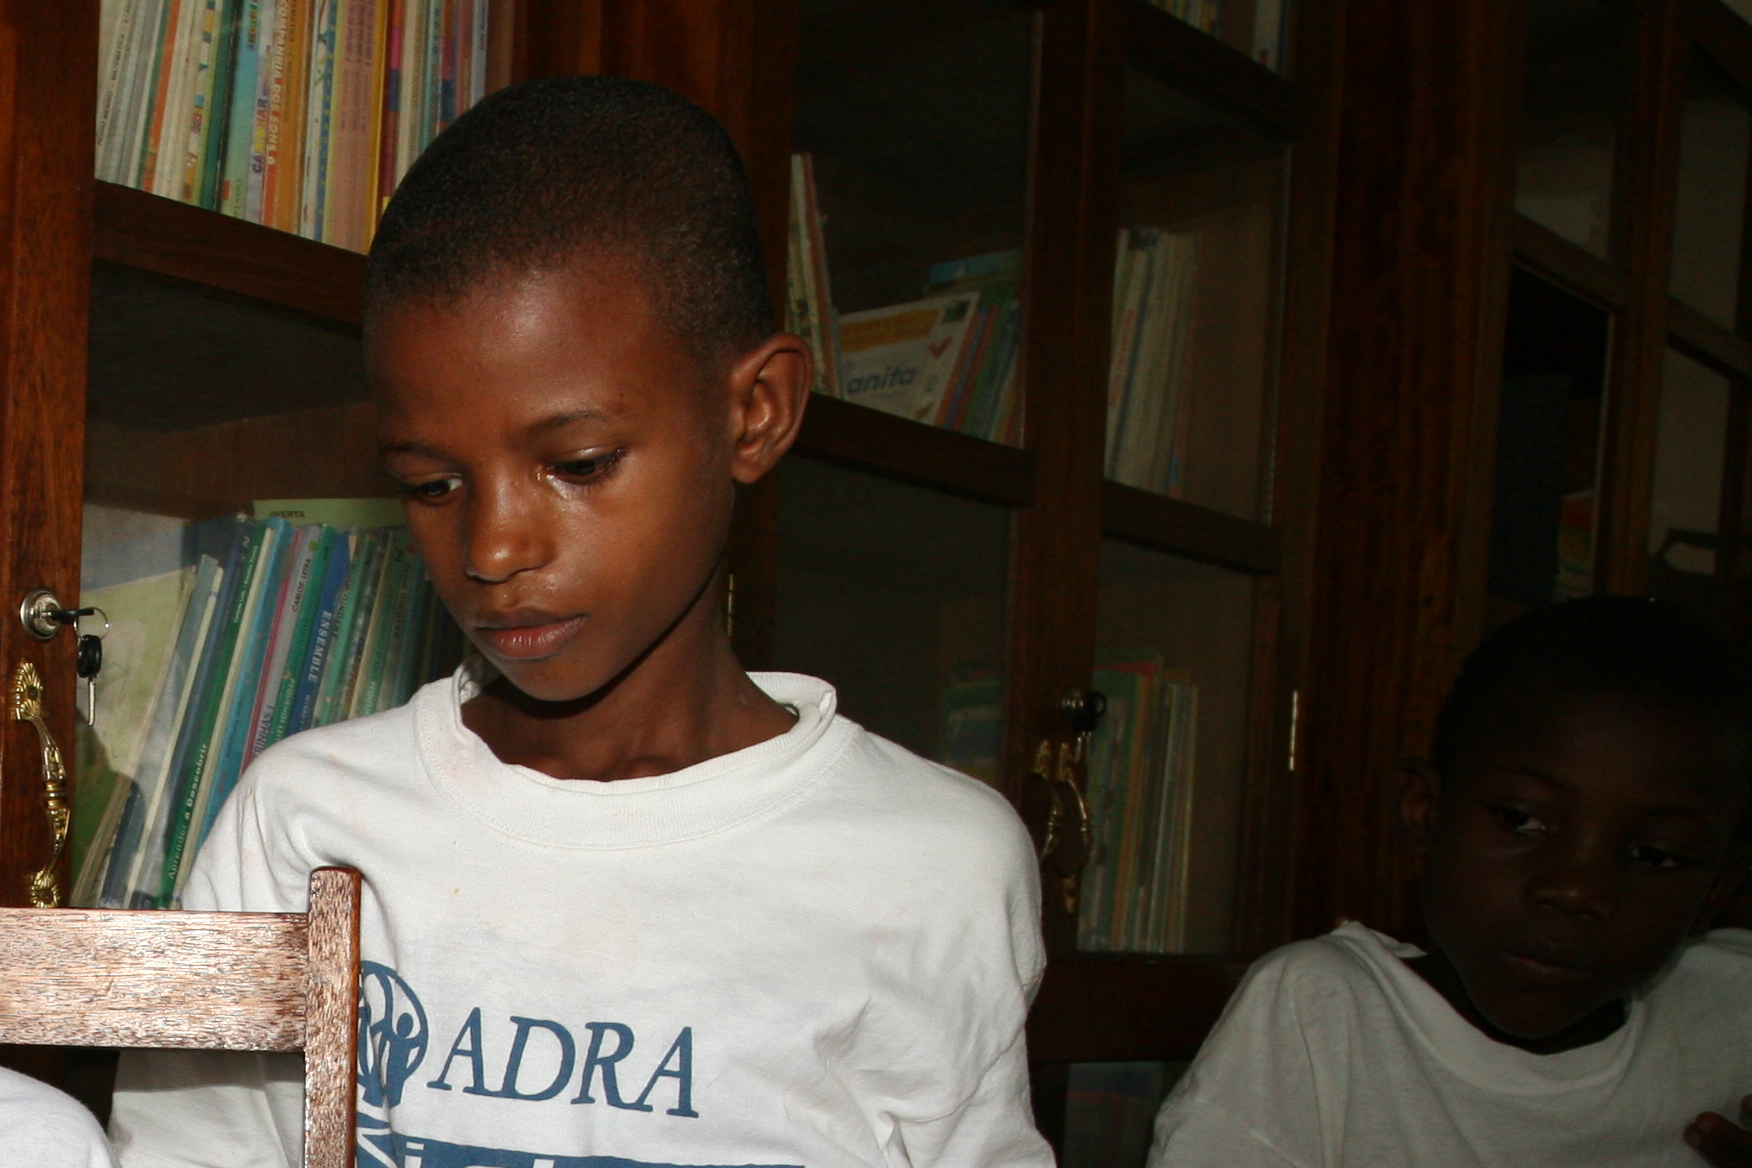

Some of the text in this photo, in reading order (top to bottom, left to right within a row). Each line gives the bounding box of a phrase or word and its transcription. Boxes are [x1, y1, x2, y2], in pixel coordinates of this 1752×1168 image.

[291, 581, 306, 612] CARLOS
[307, 610, 333, 683] ENSEMBLE
[168, 825, 187, 880] Aprender
[185, 743, 208, 809] Descobrir
[426, 1006, 701, 1119] ADRA
